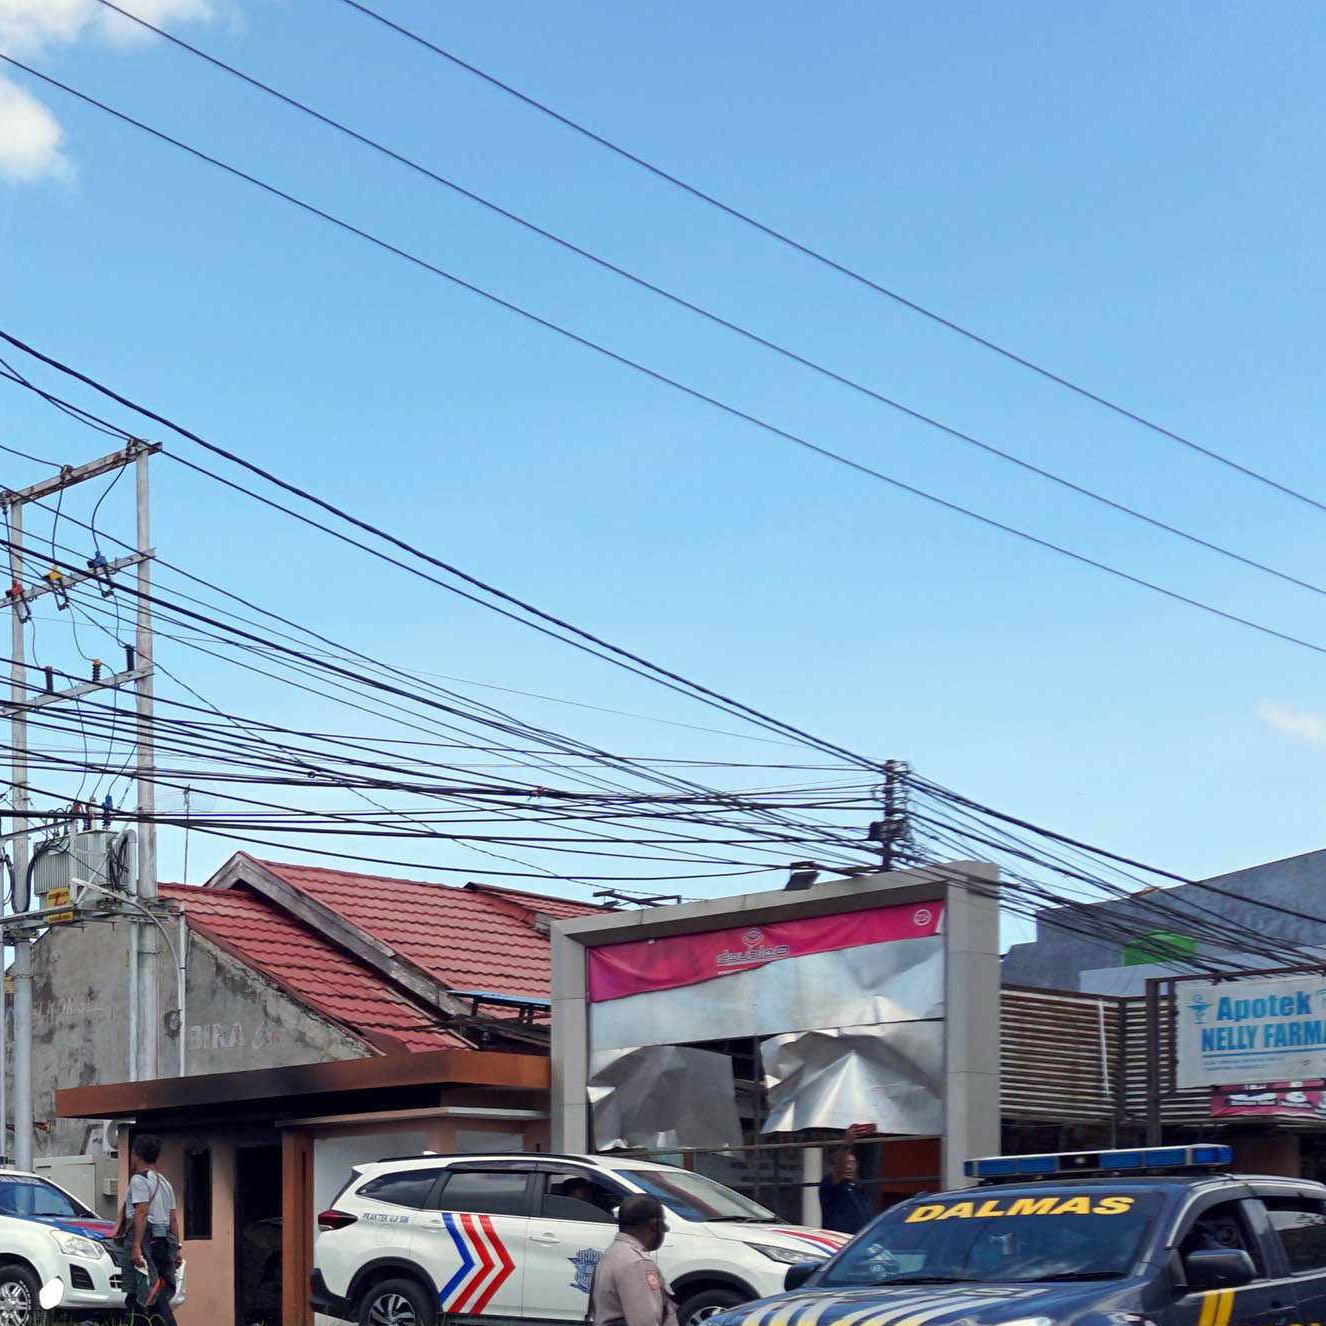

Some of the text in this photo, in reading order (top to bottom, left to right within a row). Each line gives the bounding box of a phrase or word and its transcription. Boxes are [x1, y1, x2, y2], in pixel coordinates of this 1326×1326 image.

[1217, 991, 1312, 1022] Apotek
[1201, 1025, 1258, 1052] NELLY
[904, 1196, 1136, 1223] DALMAS
